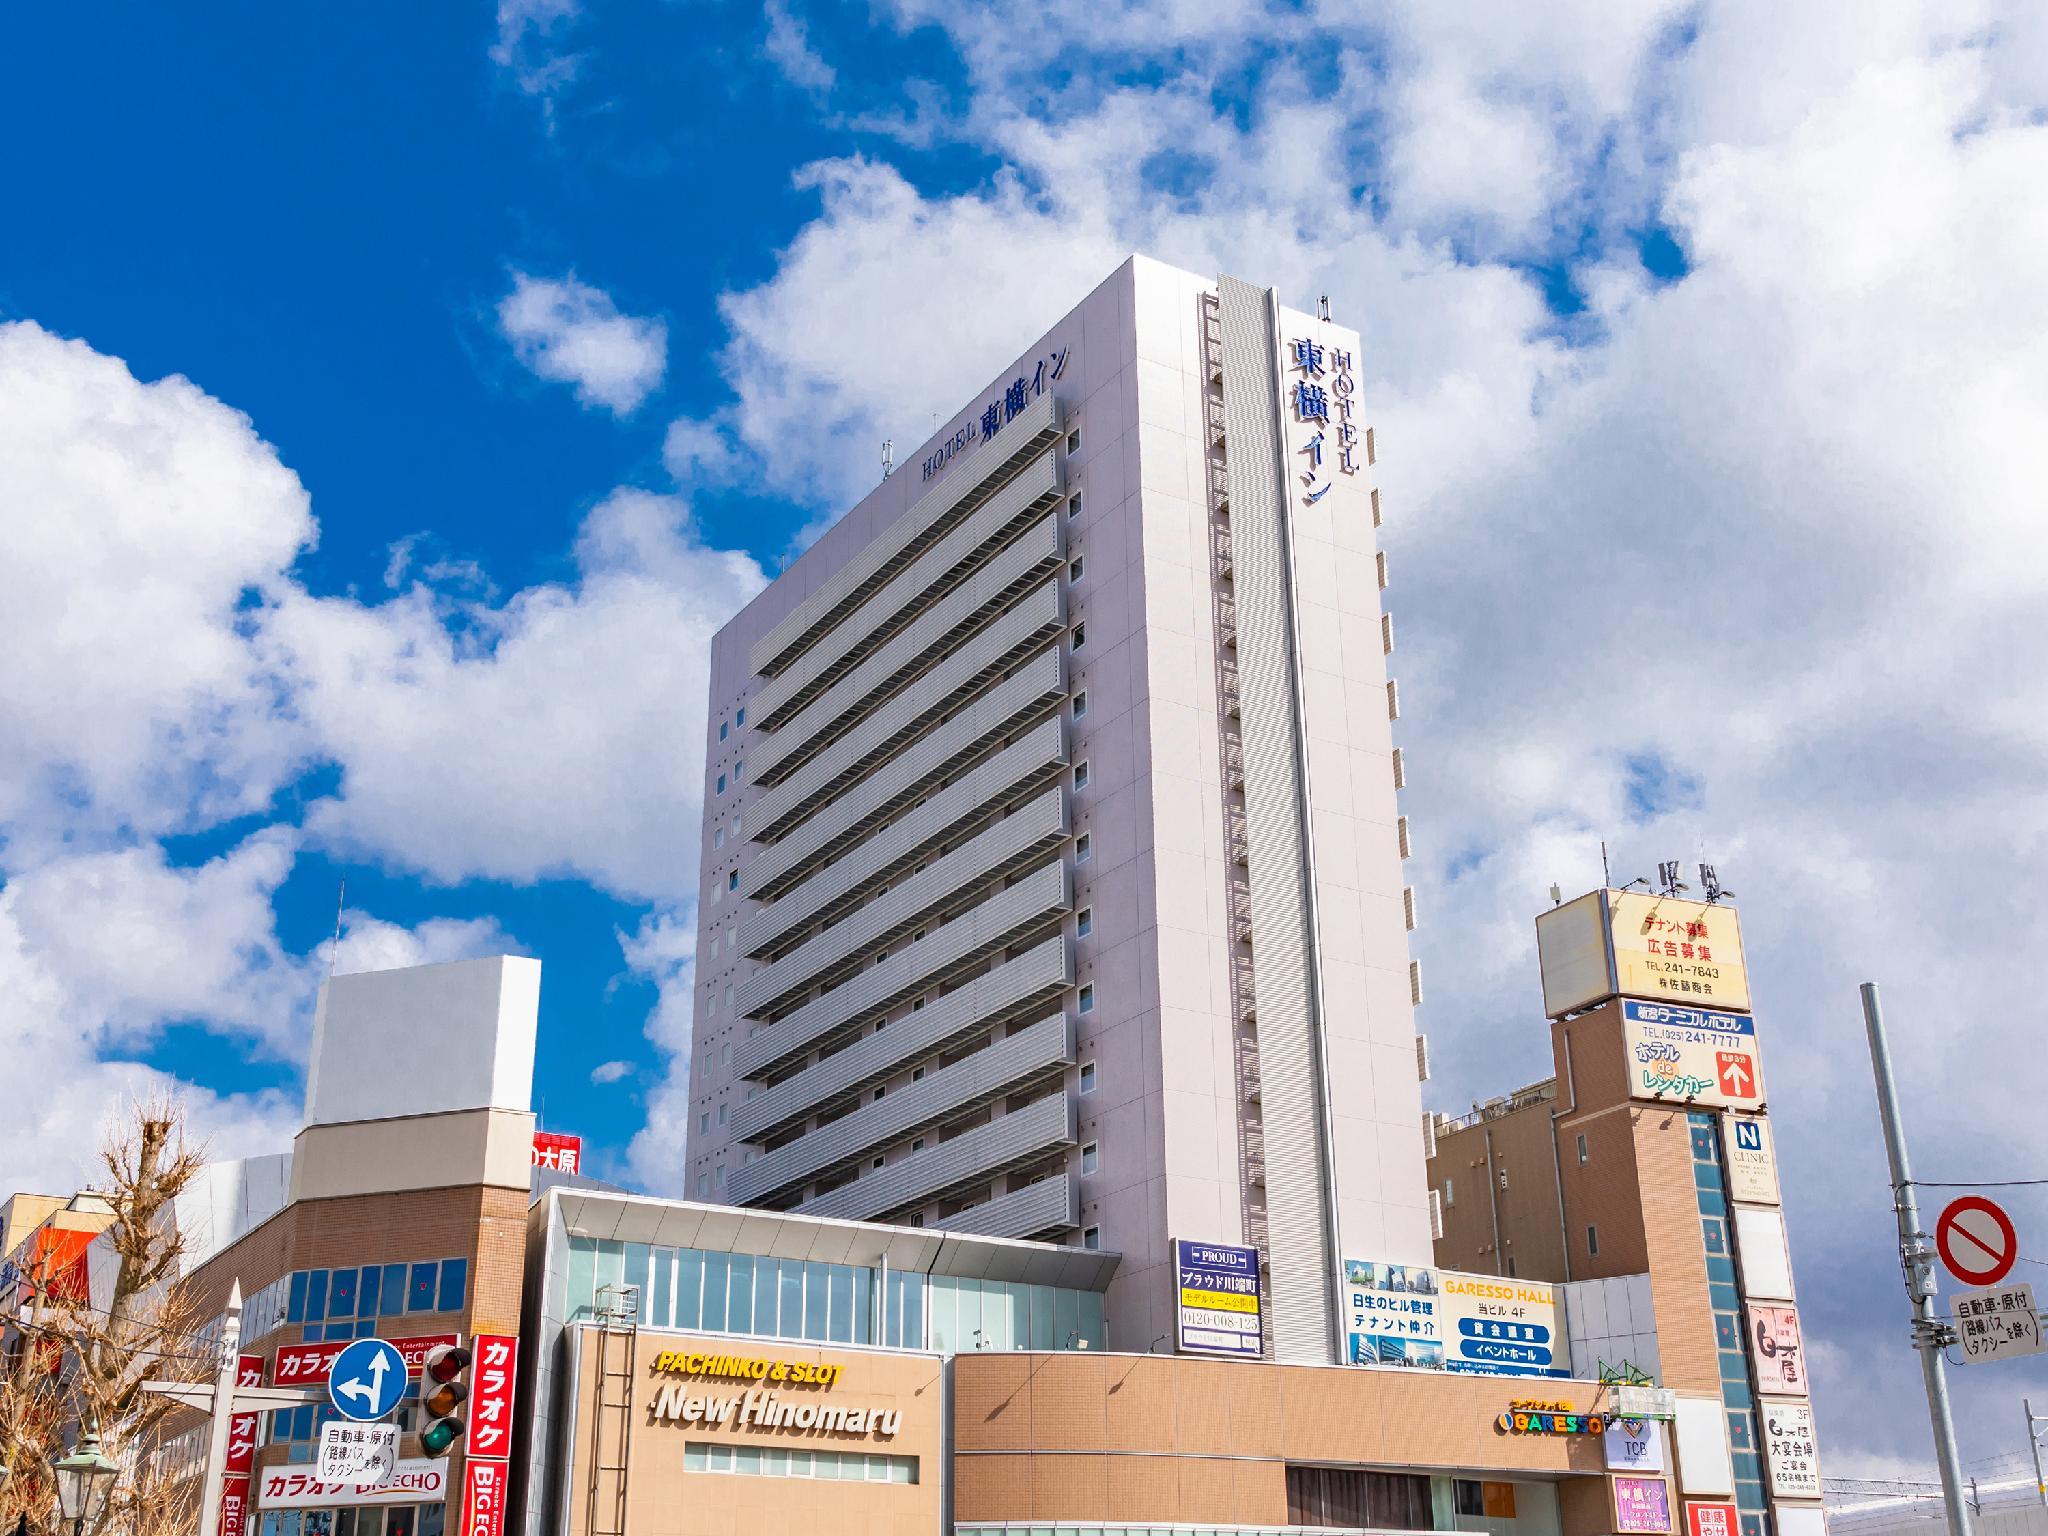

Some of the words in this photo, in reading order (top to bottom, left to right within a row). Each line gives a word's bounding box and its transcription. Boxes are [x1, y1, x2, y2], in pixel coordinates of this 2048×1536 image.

[922, 421, 977, 482] HOTEL
[980, 343, 1070, 447] 東横イン
[1335, 347, 1360, 472] HOTEL
[1293, 338, 1332, 503] 東横イン
[1644, 916, 1709, 939] テナント募集
[1647, 938, 1712, 962] 広告募集
[1635, 1041, 1680, 1063] ホテル
[1657, 1062, 1673, 1074] de
[1643, 1070, 1714, 1095] レンタカー
[1739, 1124, 1758, 1147] N
[1734, 1152, 1769, 1164] CLINIC
[1202, 1250, 1237, 1263] PROUD
[1182, 1272, 1257, 1293] プラウド川端町
[1445, 1281, 1514, 1300] GARESSO
[1517, 1289, 1556, 1304] HALL
[1185, 1293, 1256, 1309] モデルルーム公開中
[1478, 1303, 1507, 1316] 当ビル
[1511, 1307, 1526, 1318] 4F
[1958, 1291, 2028, 1318] 自動車・原付
[1184, 1311, 1258, 1330] 0120-008-125
[1355, 1314, 1435, 1335] テナント仲介
[1784, 1315, 1794, 1324] 4F
[1476, 1344, 1537, 1361] イベントホール
[657, 1351, 769, 1379] PACHINKO
[771, 1360, 788, 1382] &
[792, 1362, 847, 1385] SLOT
[476, 1342, 510, 1448] カラオケ
[229, 1368, 262, 1459] カオケ
[655, 1383, 741, 1423] New
[738, 1390, 904, 1435] Hinomaru
[1797, 1409, 1809, 1419] 3F
[1514, 1413, 1603, 1434] GARESSO
[328, 1429, 396, 1446] 自動車・原付
[1625, 1441, 1647, 1456] TCB
[1772, 1441, 1813, 1457] 大宴会場
[1782, 1460, 1807, 1470] ご宴会
[474, 1466, 494, 1510] BIG
[1621, 1487, 1663, 1502] 東横イン
[226, 1496, 240, 1528] BIG
